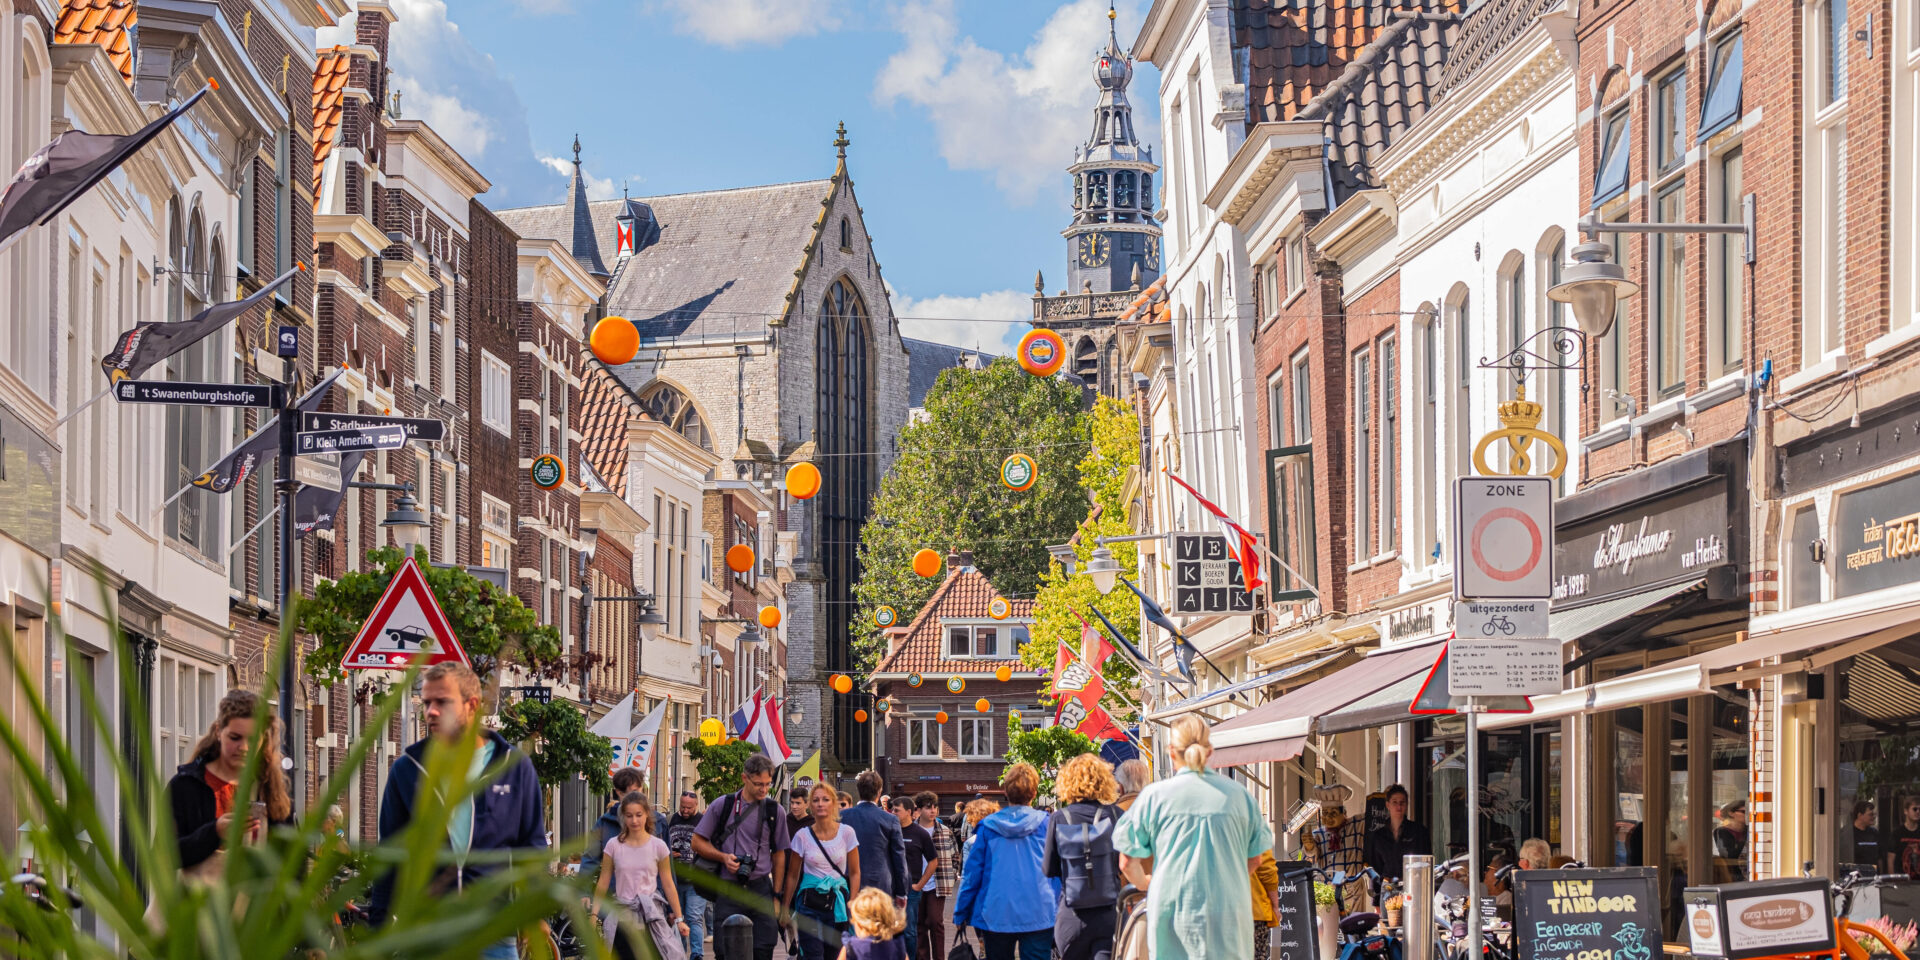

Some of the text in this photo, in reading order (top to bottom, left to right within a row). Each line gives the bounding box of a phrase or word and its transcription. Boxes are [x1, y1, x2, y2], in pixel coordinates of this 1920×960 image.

[142, 388, 255, 404] 't Swanenburghshofje
[316, 436, 336, 448] Klein
[338, 434, 372, 447] Amerika
[1486, 485, 1525, 496] ZONE
[1606, 516, 1670, 575] Huyskamer
[1682, 534, 1720, 568] van Herfst
[1846, 544, 1884, 571] restaurant
[1554, 574, 1584, 600] inds 1922
[1470, 604, 1535, 615] uitgezonderd
[1552, 880, 1593, 898] NEW
[1547, 895, 1637, 914] TANDOOR
[1762, 904, 1796, 917] tandoor
[1535, 921, 1562, 938] Een
[1530, 938, 1548, 951] In
